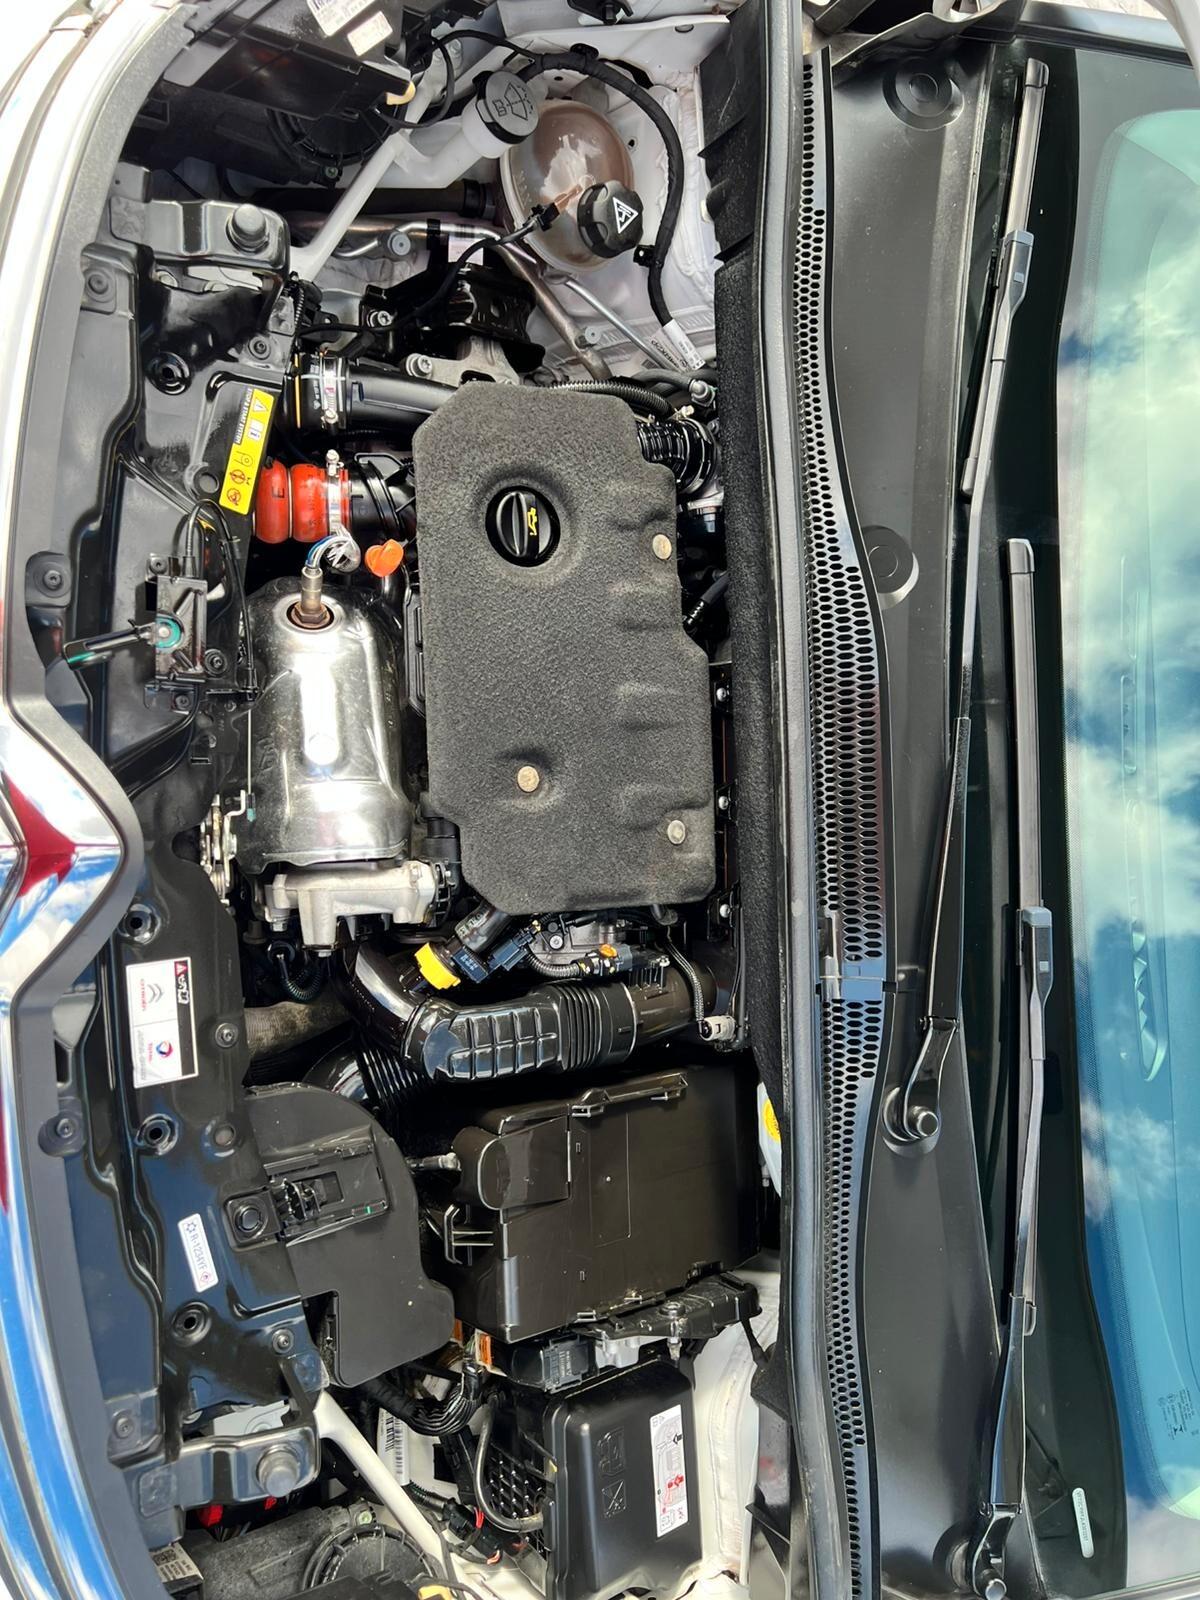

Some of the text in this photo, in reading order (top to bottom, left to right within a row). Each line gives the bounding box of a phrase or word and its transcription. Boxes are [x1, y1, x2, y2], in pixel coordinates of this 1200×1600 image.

[244, 388, 253, 401] STOP
[239, 406, 248, 423] START
[235, 423, 245, 444] SYSTEM
